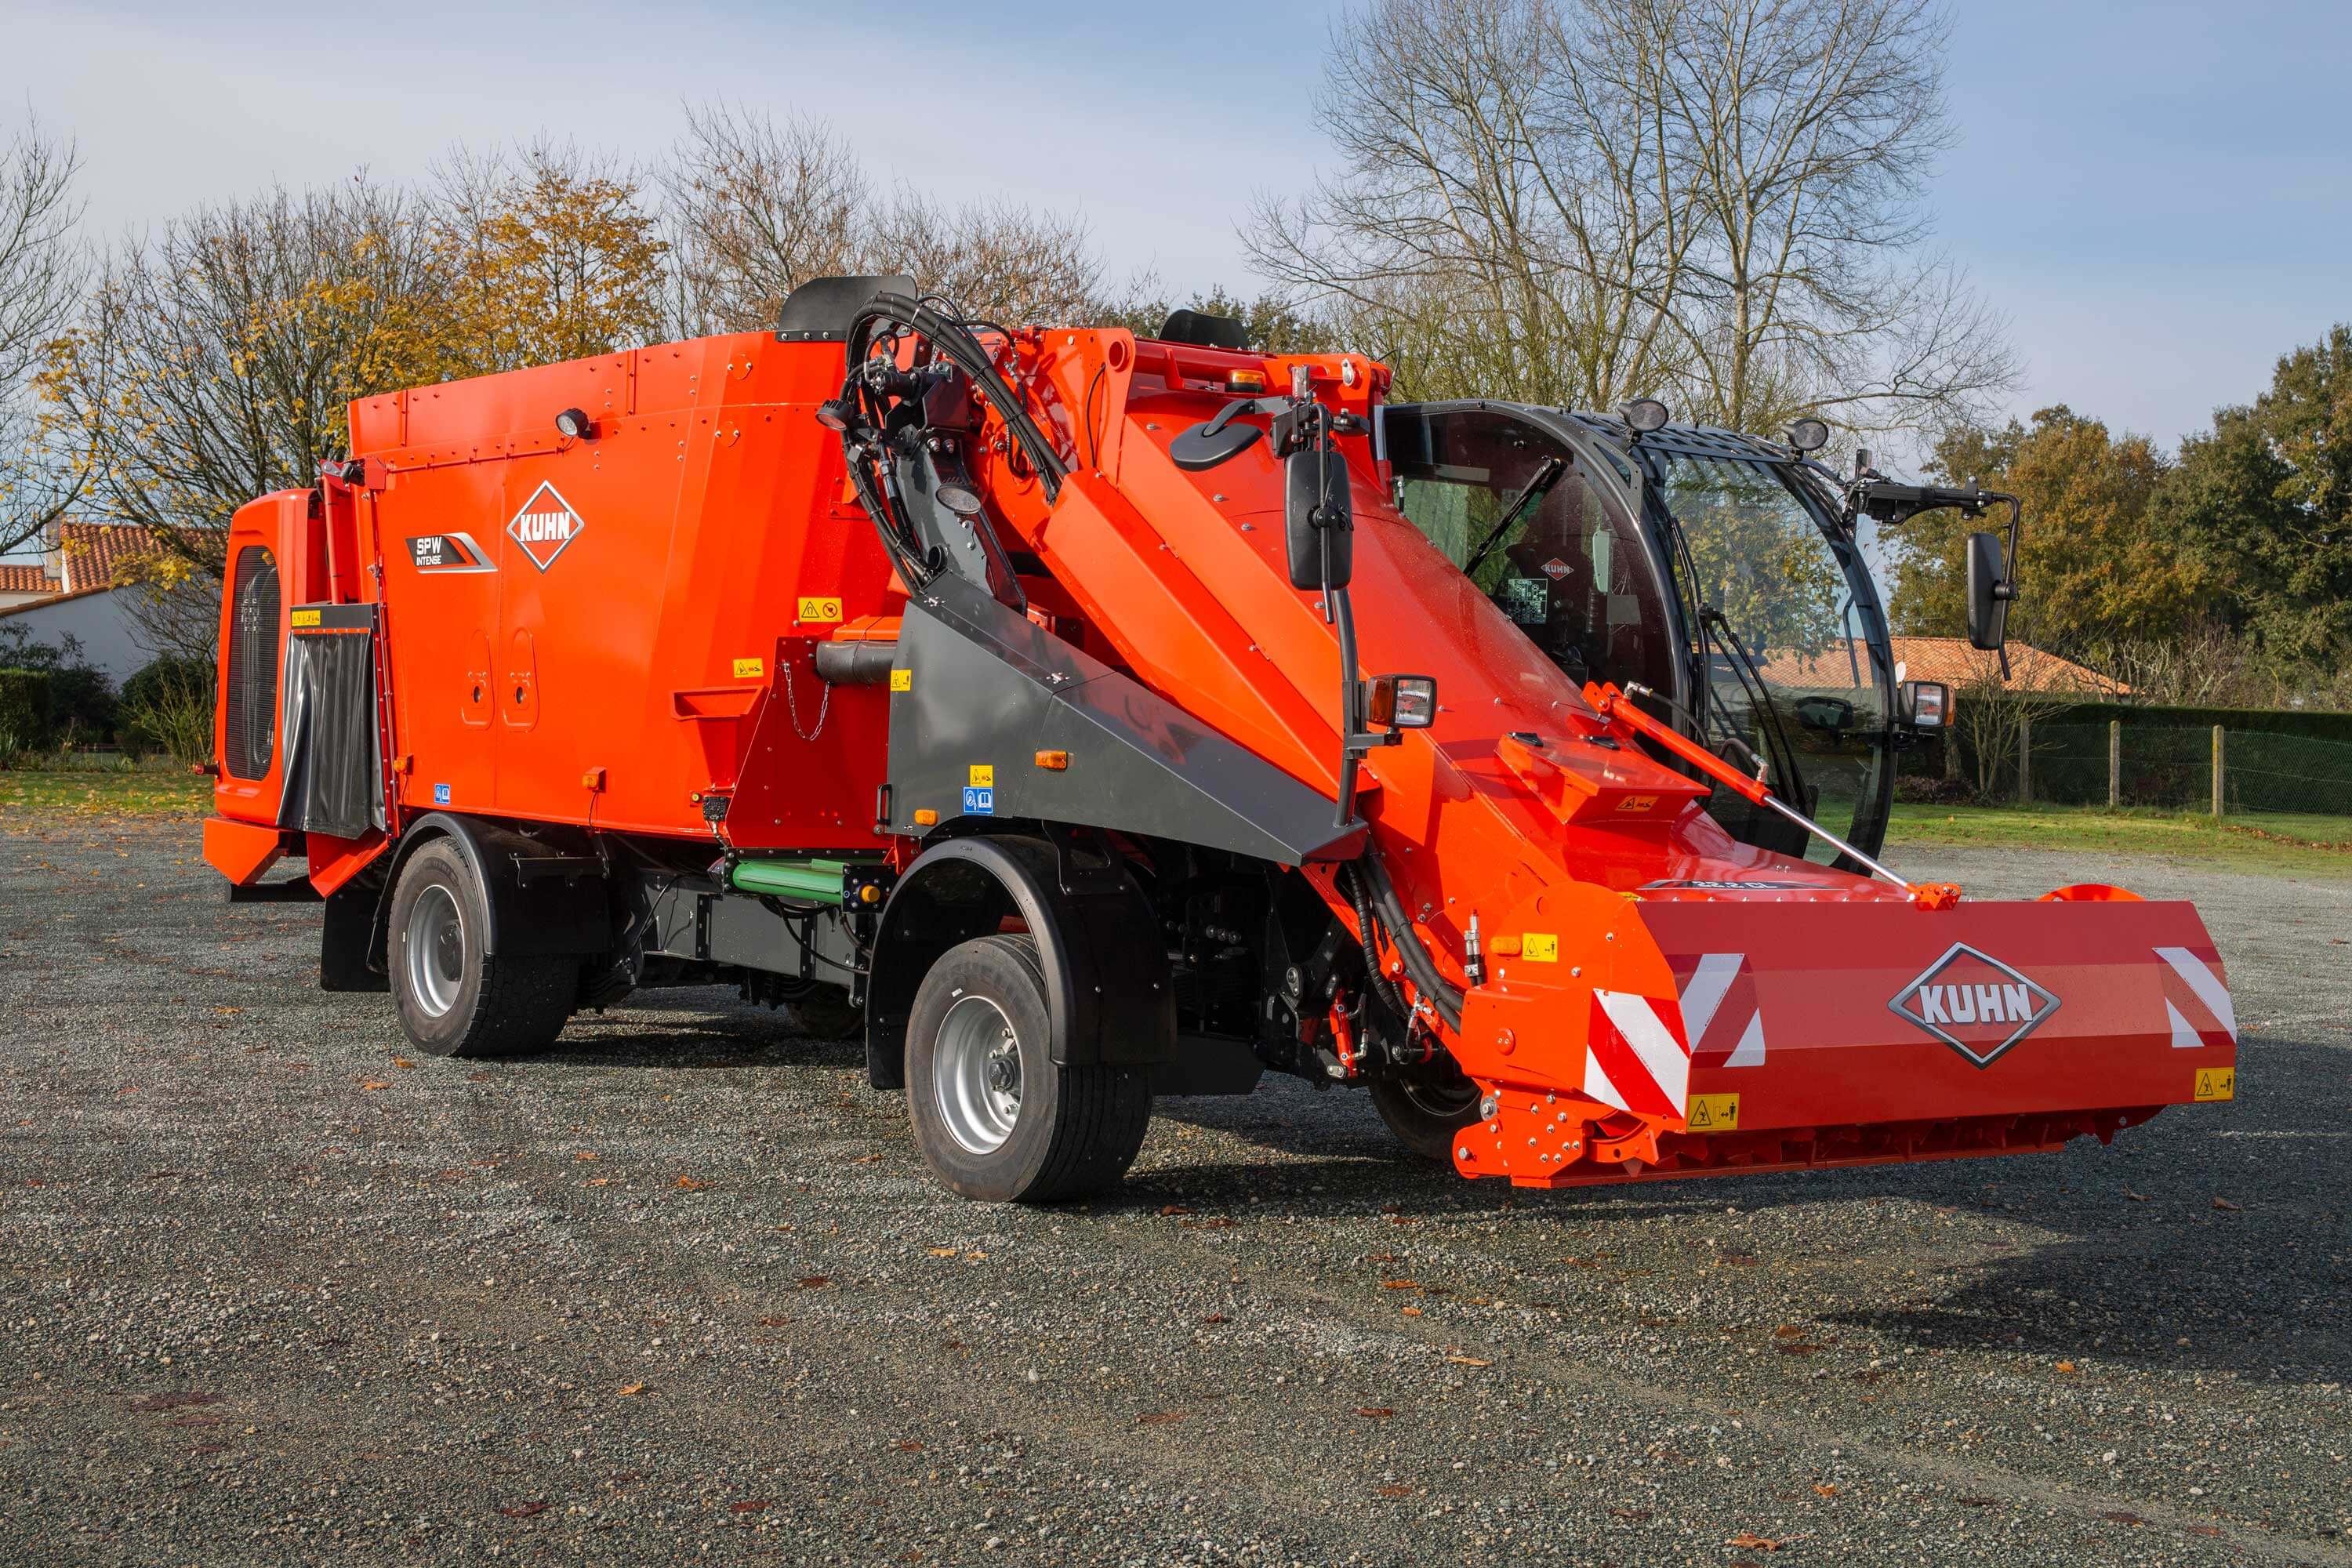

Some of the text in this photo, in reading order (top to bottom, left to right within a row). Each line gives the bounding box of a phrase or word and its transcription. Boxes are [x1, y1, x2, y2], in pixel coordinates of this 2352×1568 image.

[520, 511, 571, 543] KUHN
[416, 536, 442, 555] SPW
[416, 555, 442, 566] INTENSE
[1544, 564, 1570, 574] KUHN
[1918, 984, 2033, 1024] KUHN
